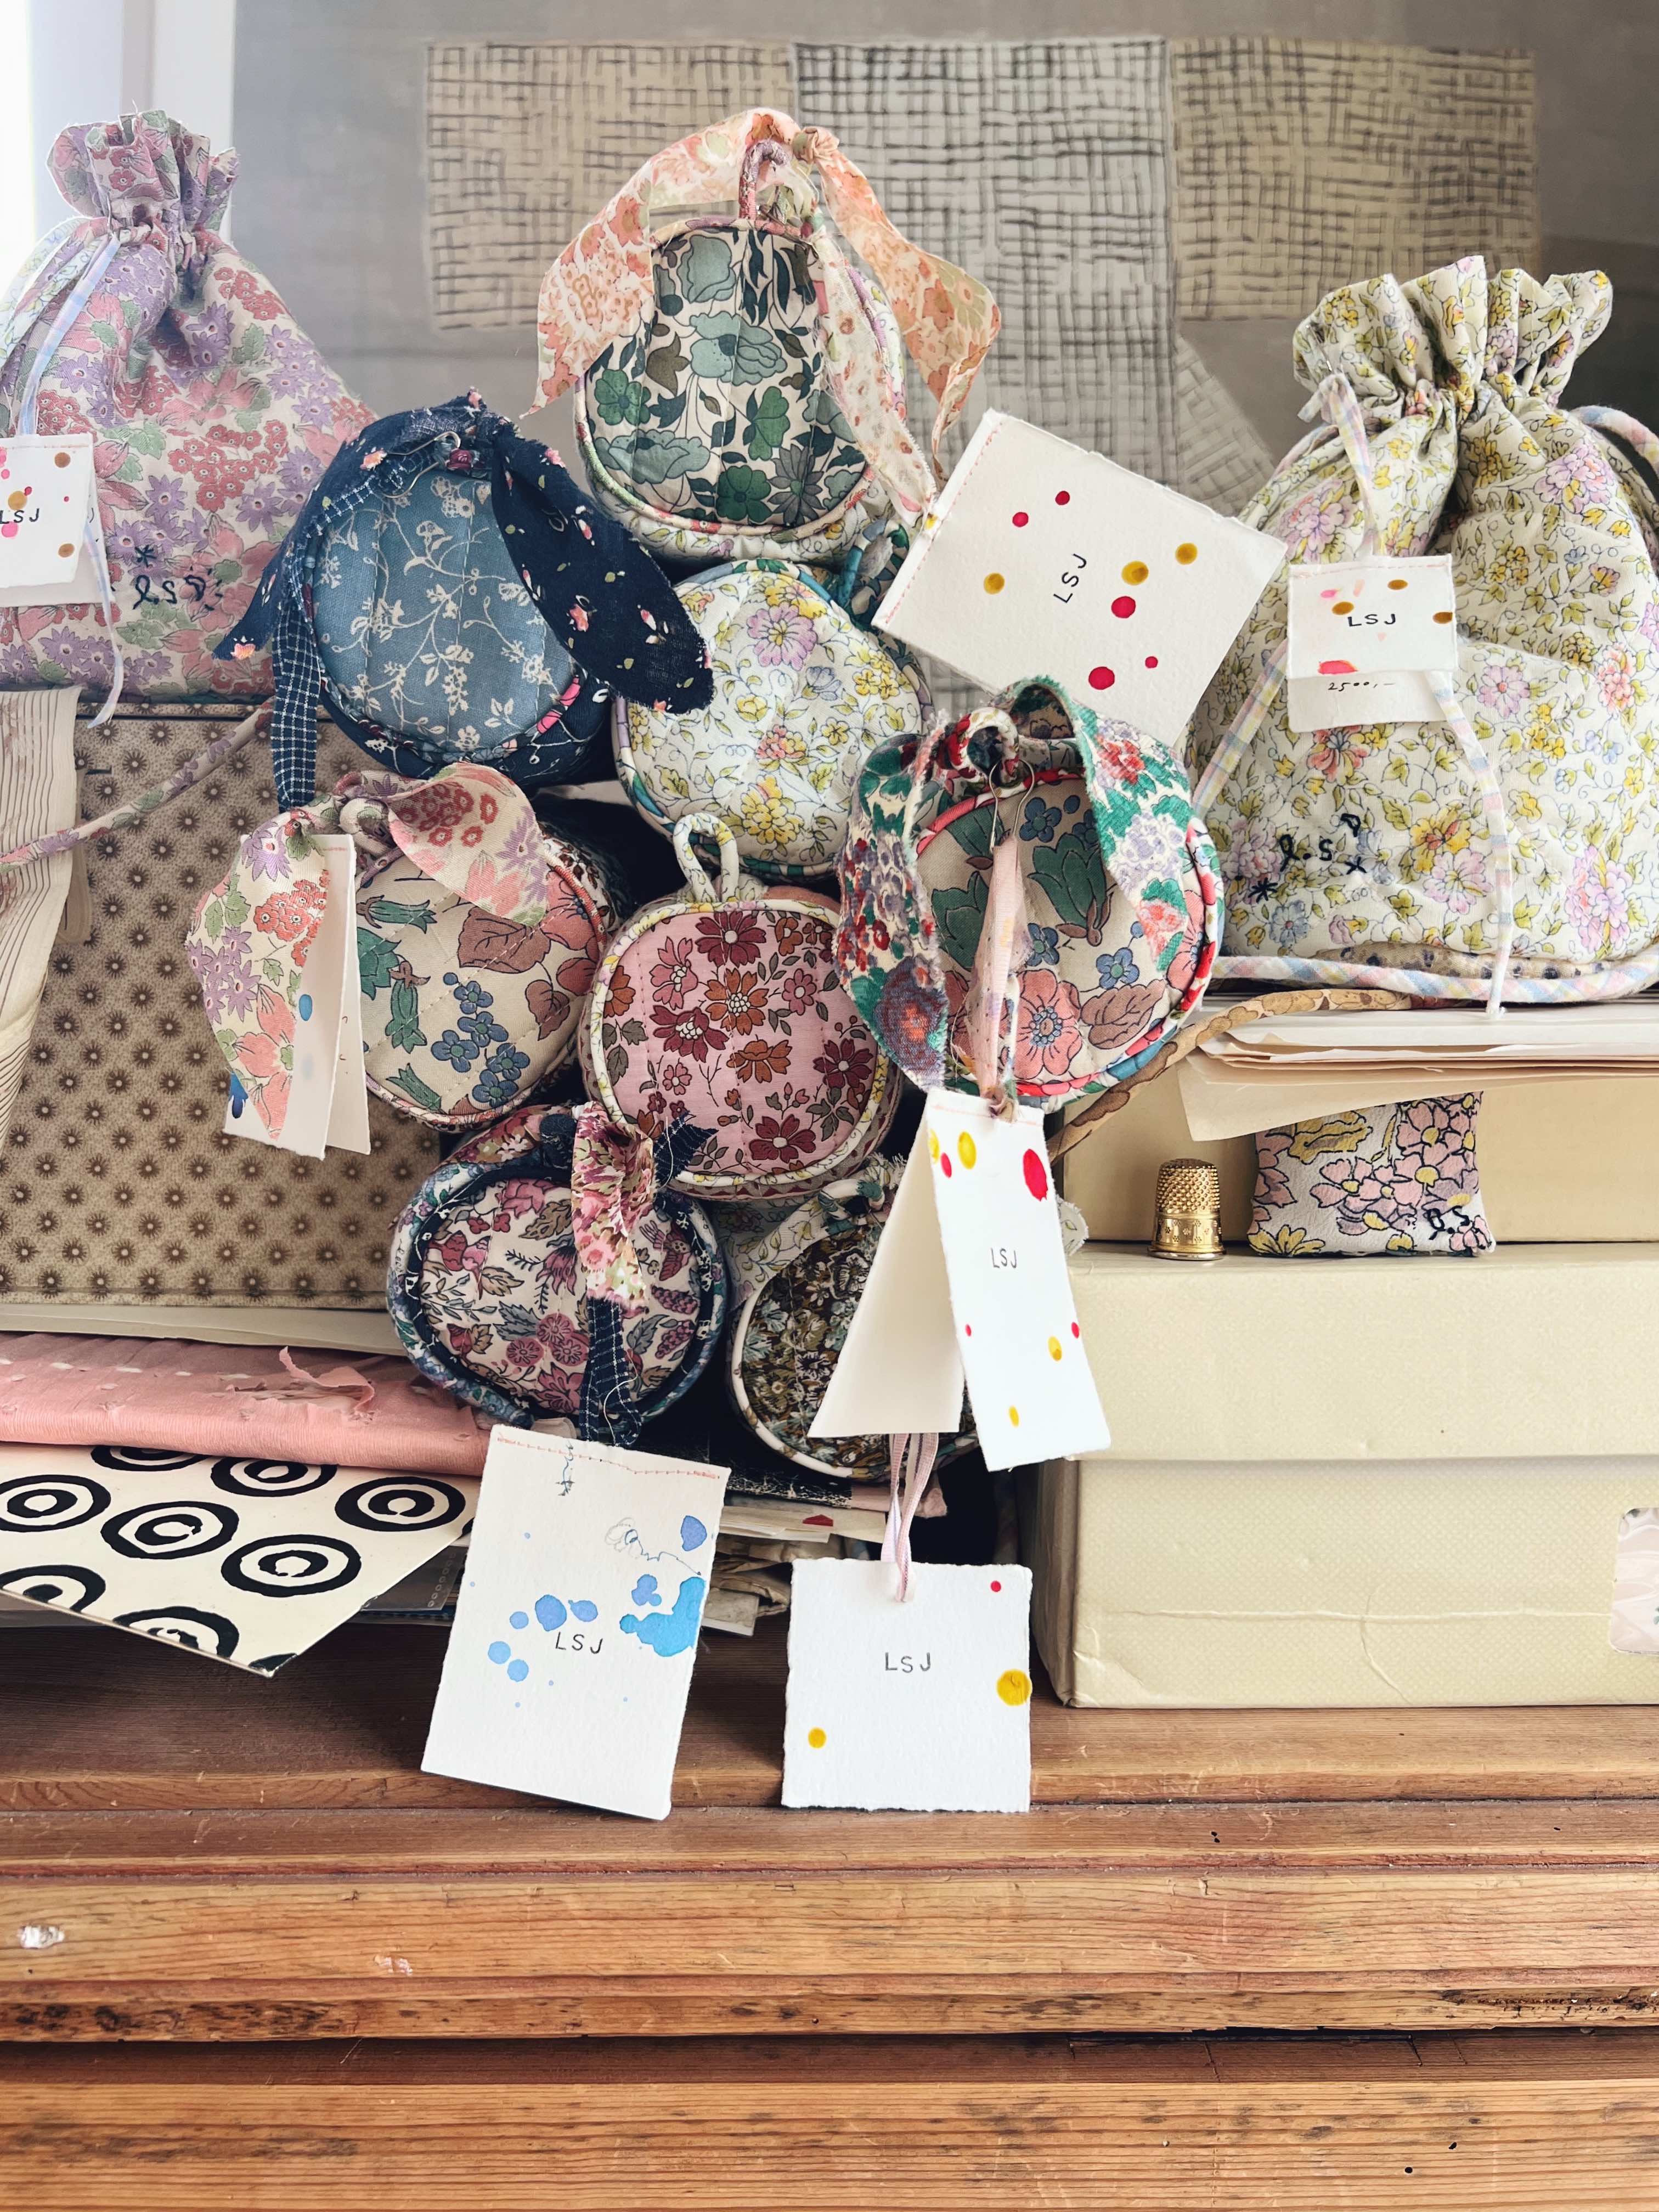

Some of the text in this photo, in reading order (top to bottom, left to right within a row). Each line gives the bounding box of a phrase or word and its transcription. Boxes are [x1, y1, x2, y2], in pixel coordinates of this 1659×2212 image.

[1053, 553, 1087, 603] LSJ
[1347, 613, 1396, 627] LSJ
[990, 1248, 1017, 1268] LSJ
[555, 1631, 603, 1654] LSJ
[885, 1652, 931, 1673] LSJ
